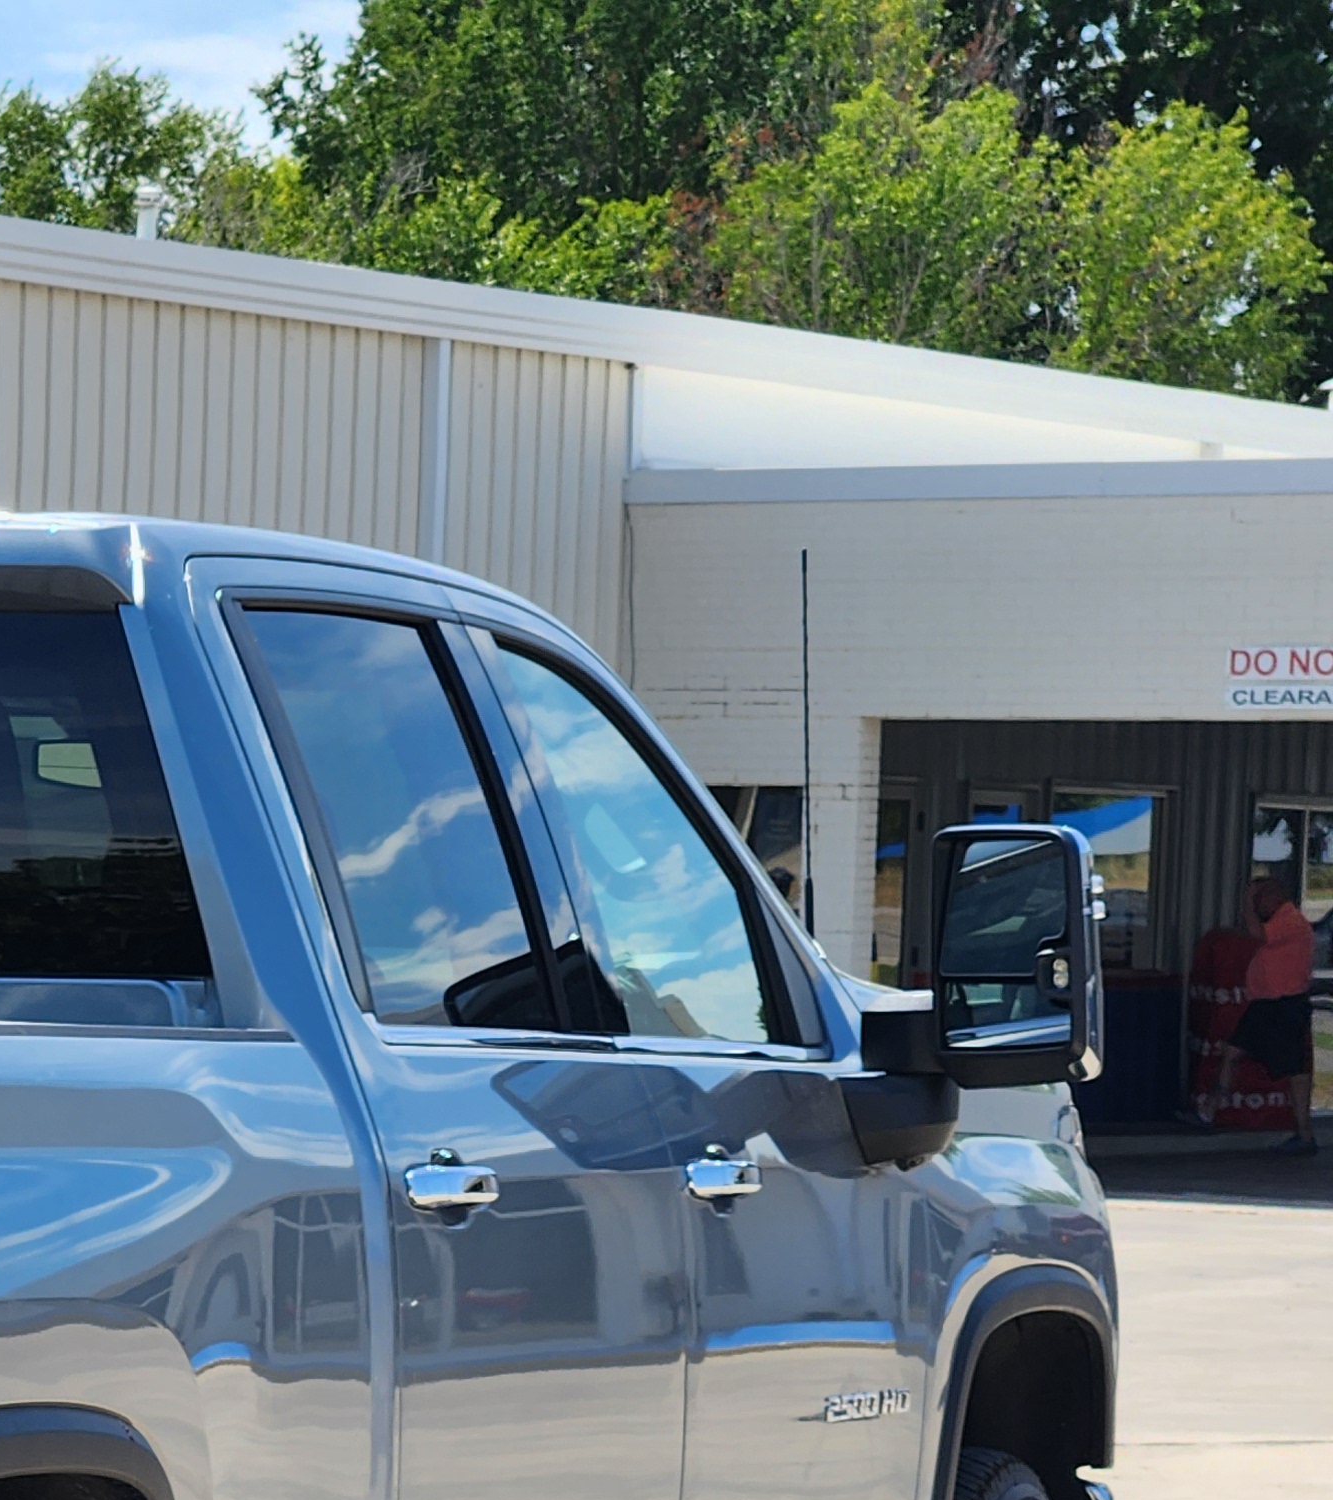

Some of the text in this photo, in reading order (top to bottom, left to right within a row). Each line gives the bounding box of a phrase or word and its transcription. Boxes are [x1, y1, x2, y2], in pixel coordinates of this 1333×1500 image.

[1231, 649, 1278, 676] DO
[823, 1387, 910, 1423] 2500 HD
